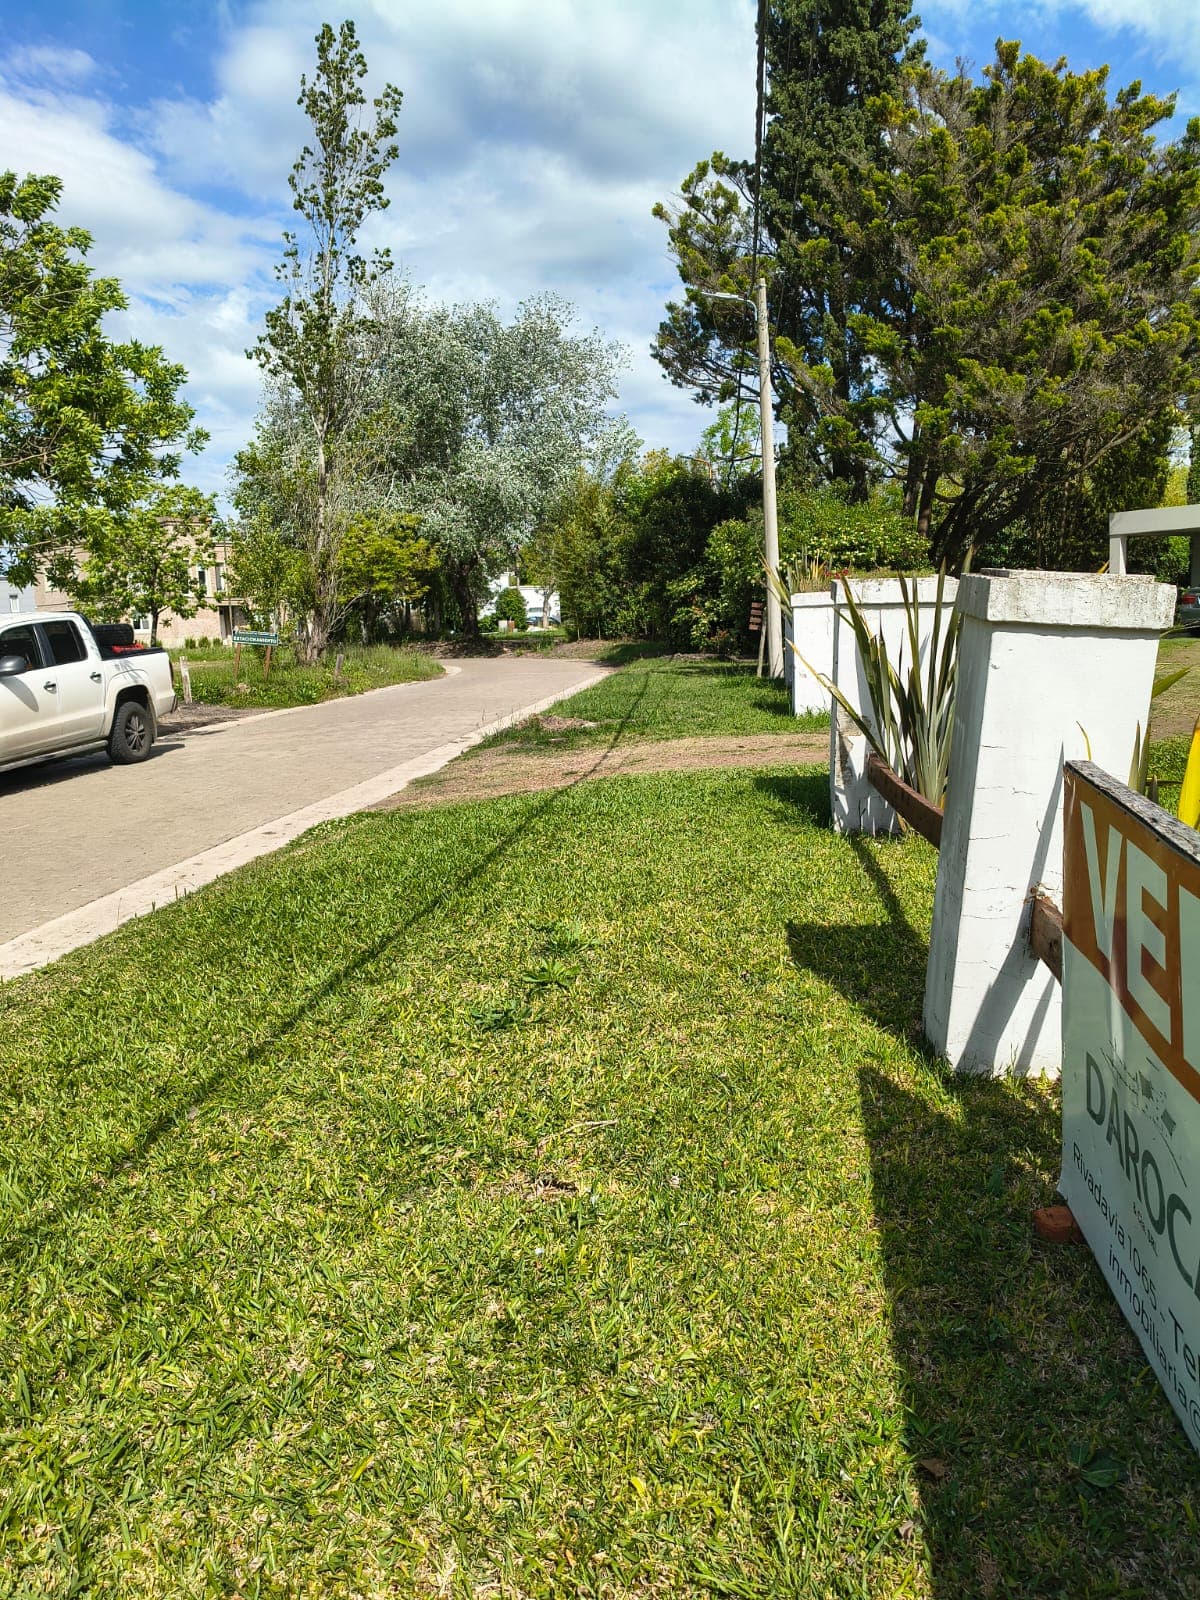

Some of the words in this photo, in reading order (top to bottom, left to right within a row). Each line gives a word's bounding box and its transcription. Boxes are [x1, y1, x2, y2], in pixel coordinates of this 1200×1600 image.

[1073, 1142, 1125, 1249] Rivadavia
[1128, 1235, 1158, 1311] 1065
[1086, 1051, 1200, 1302] DAROC
